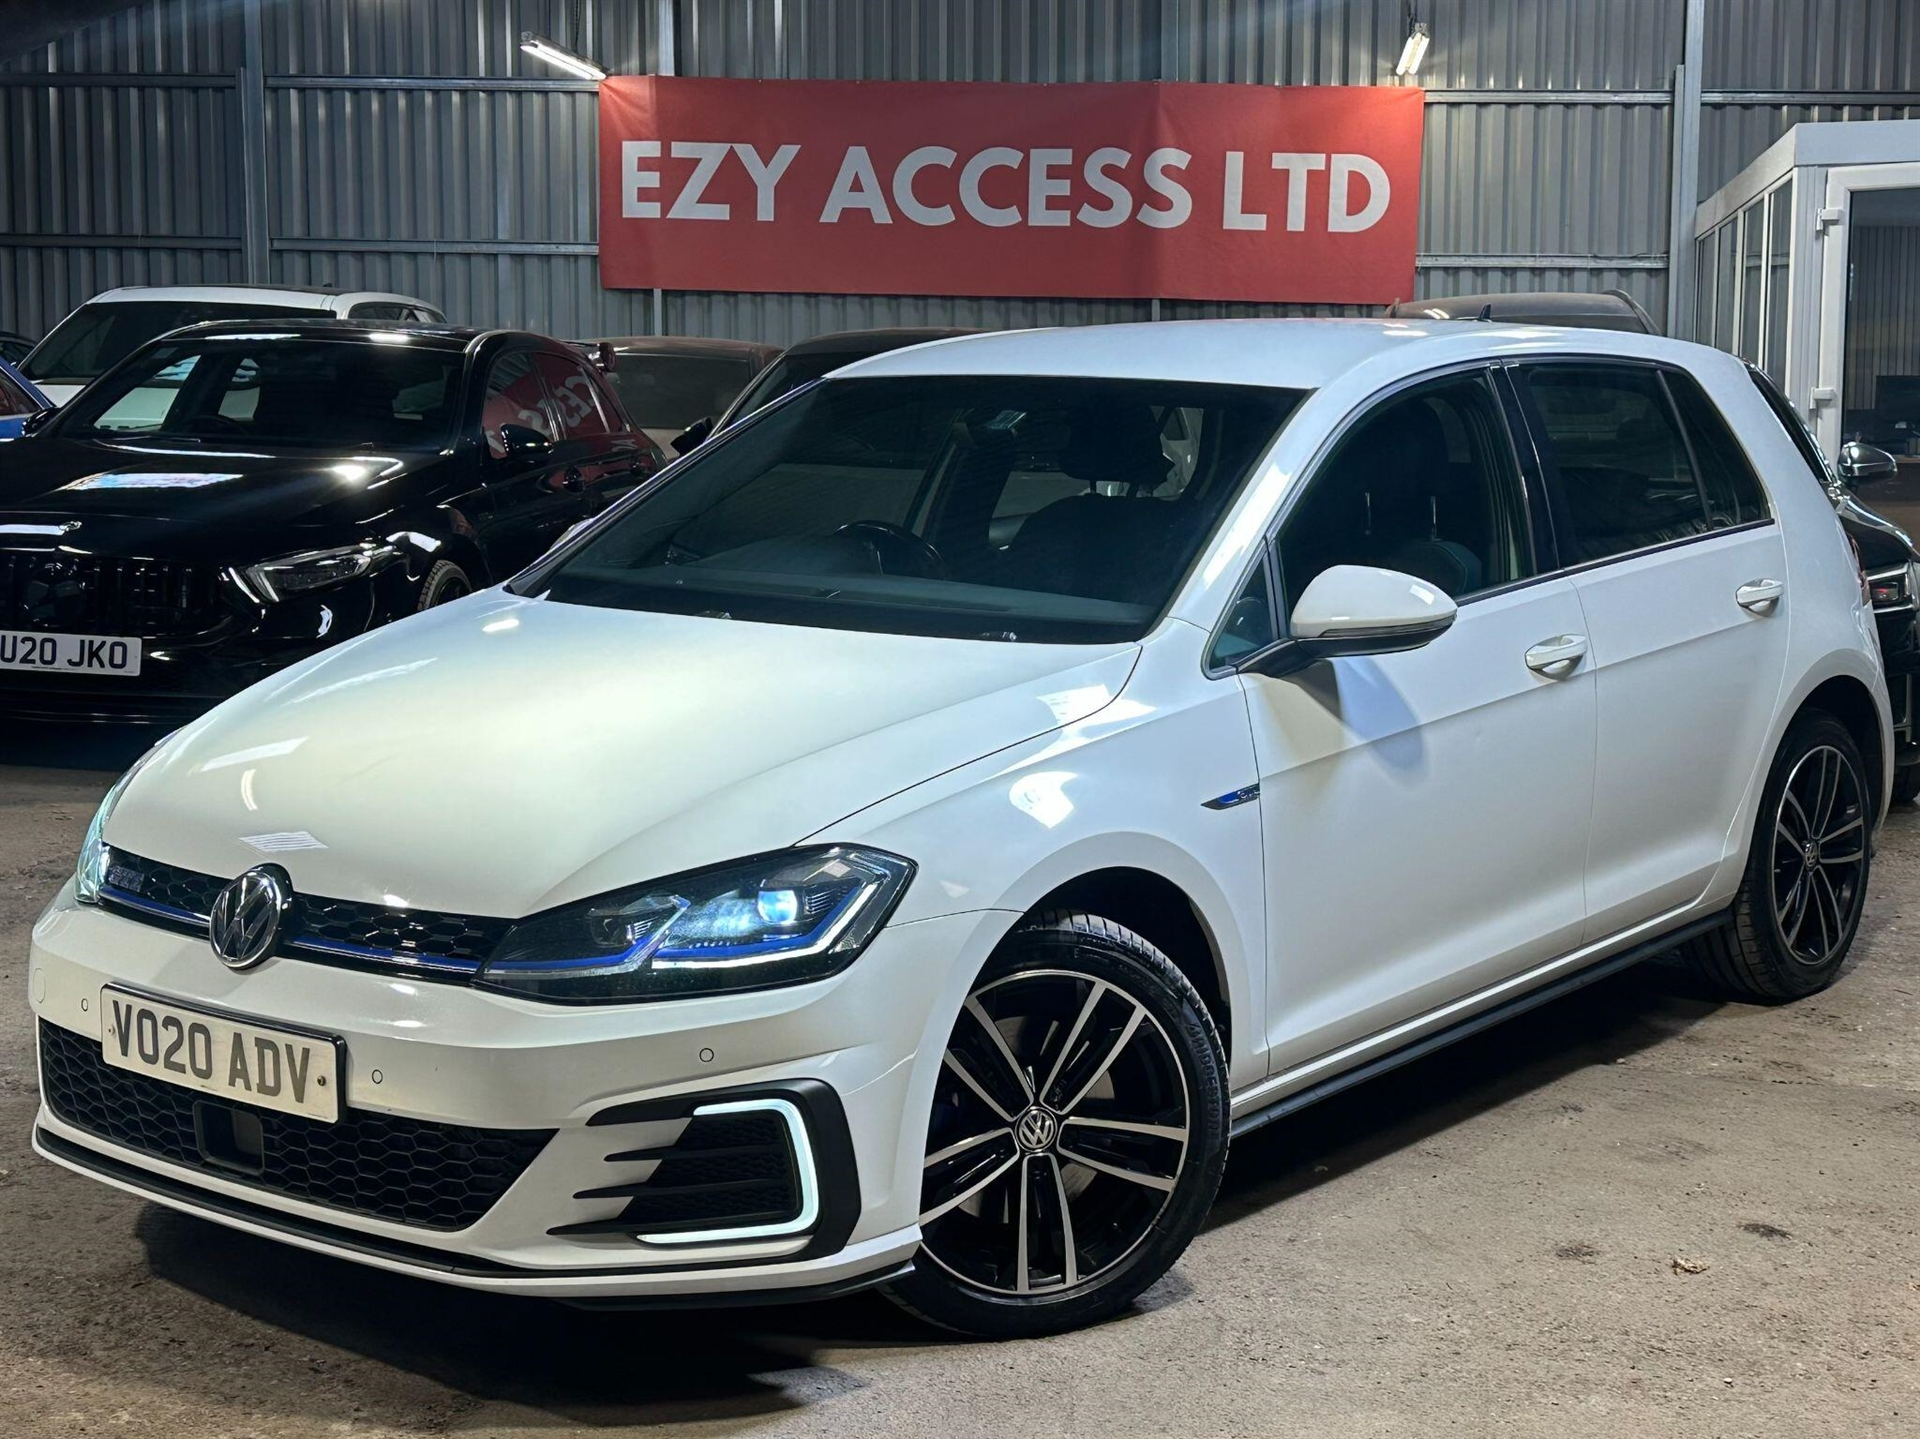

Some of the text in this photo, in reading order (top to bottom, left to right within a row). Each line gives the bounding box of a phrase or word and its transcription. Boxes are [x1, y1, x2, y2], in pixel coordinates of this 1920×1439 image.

[622, 141, 1391, 233] EZY ACCESS LTD
[66, 640, 128, 669] JKO
[112, 1000, 311, 1104] VO20 ADV
